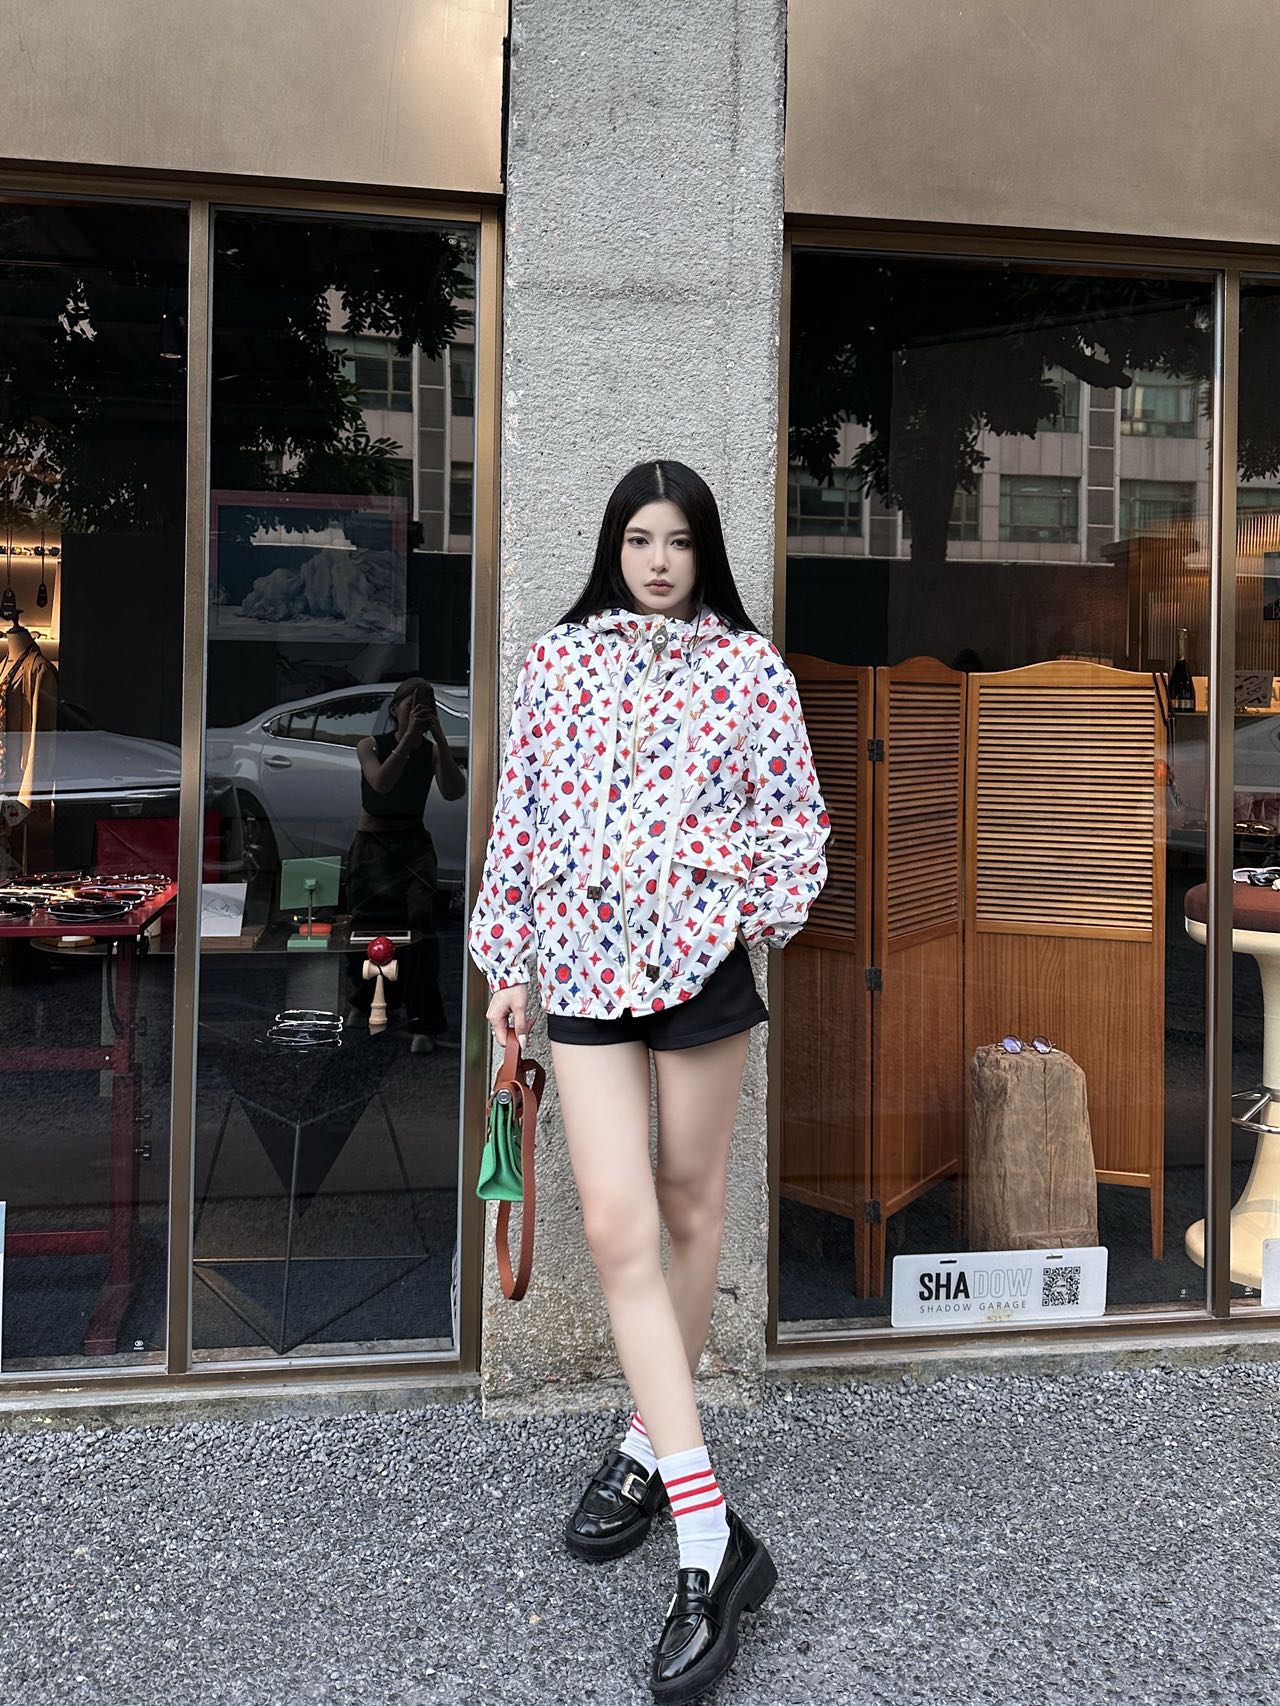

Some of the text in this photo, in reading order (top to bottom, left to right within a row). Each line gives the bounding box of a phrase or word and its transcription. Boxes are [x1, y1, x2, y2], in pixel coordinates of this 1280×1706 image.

[741, 656, 756, 673] LV
[538, 805, 550, 825] LV
[919, 1268, 1032, 1301] SHADOW
[920, 1300, 1026, 1313] SHADOW GARAGE
